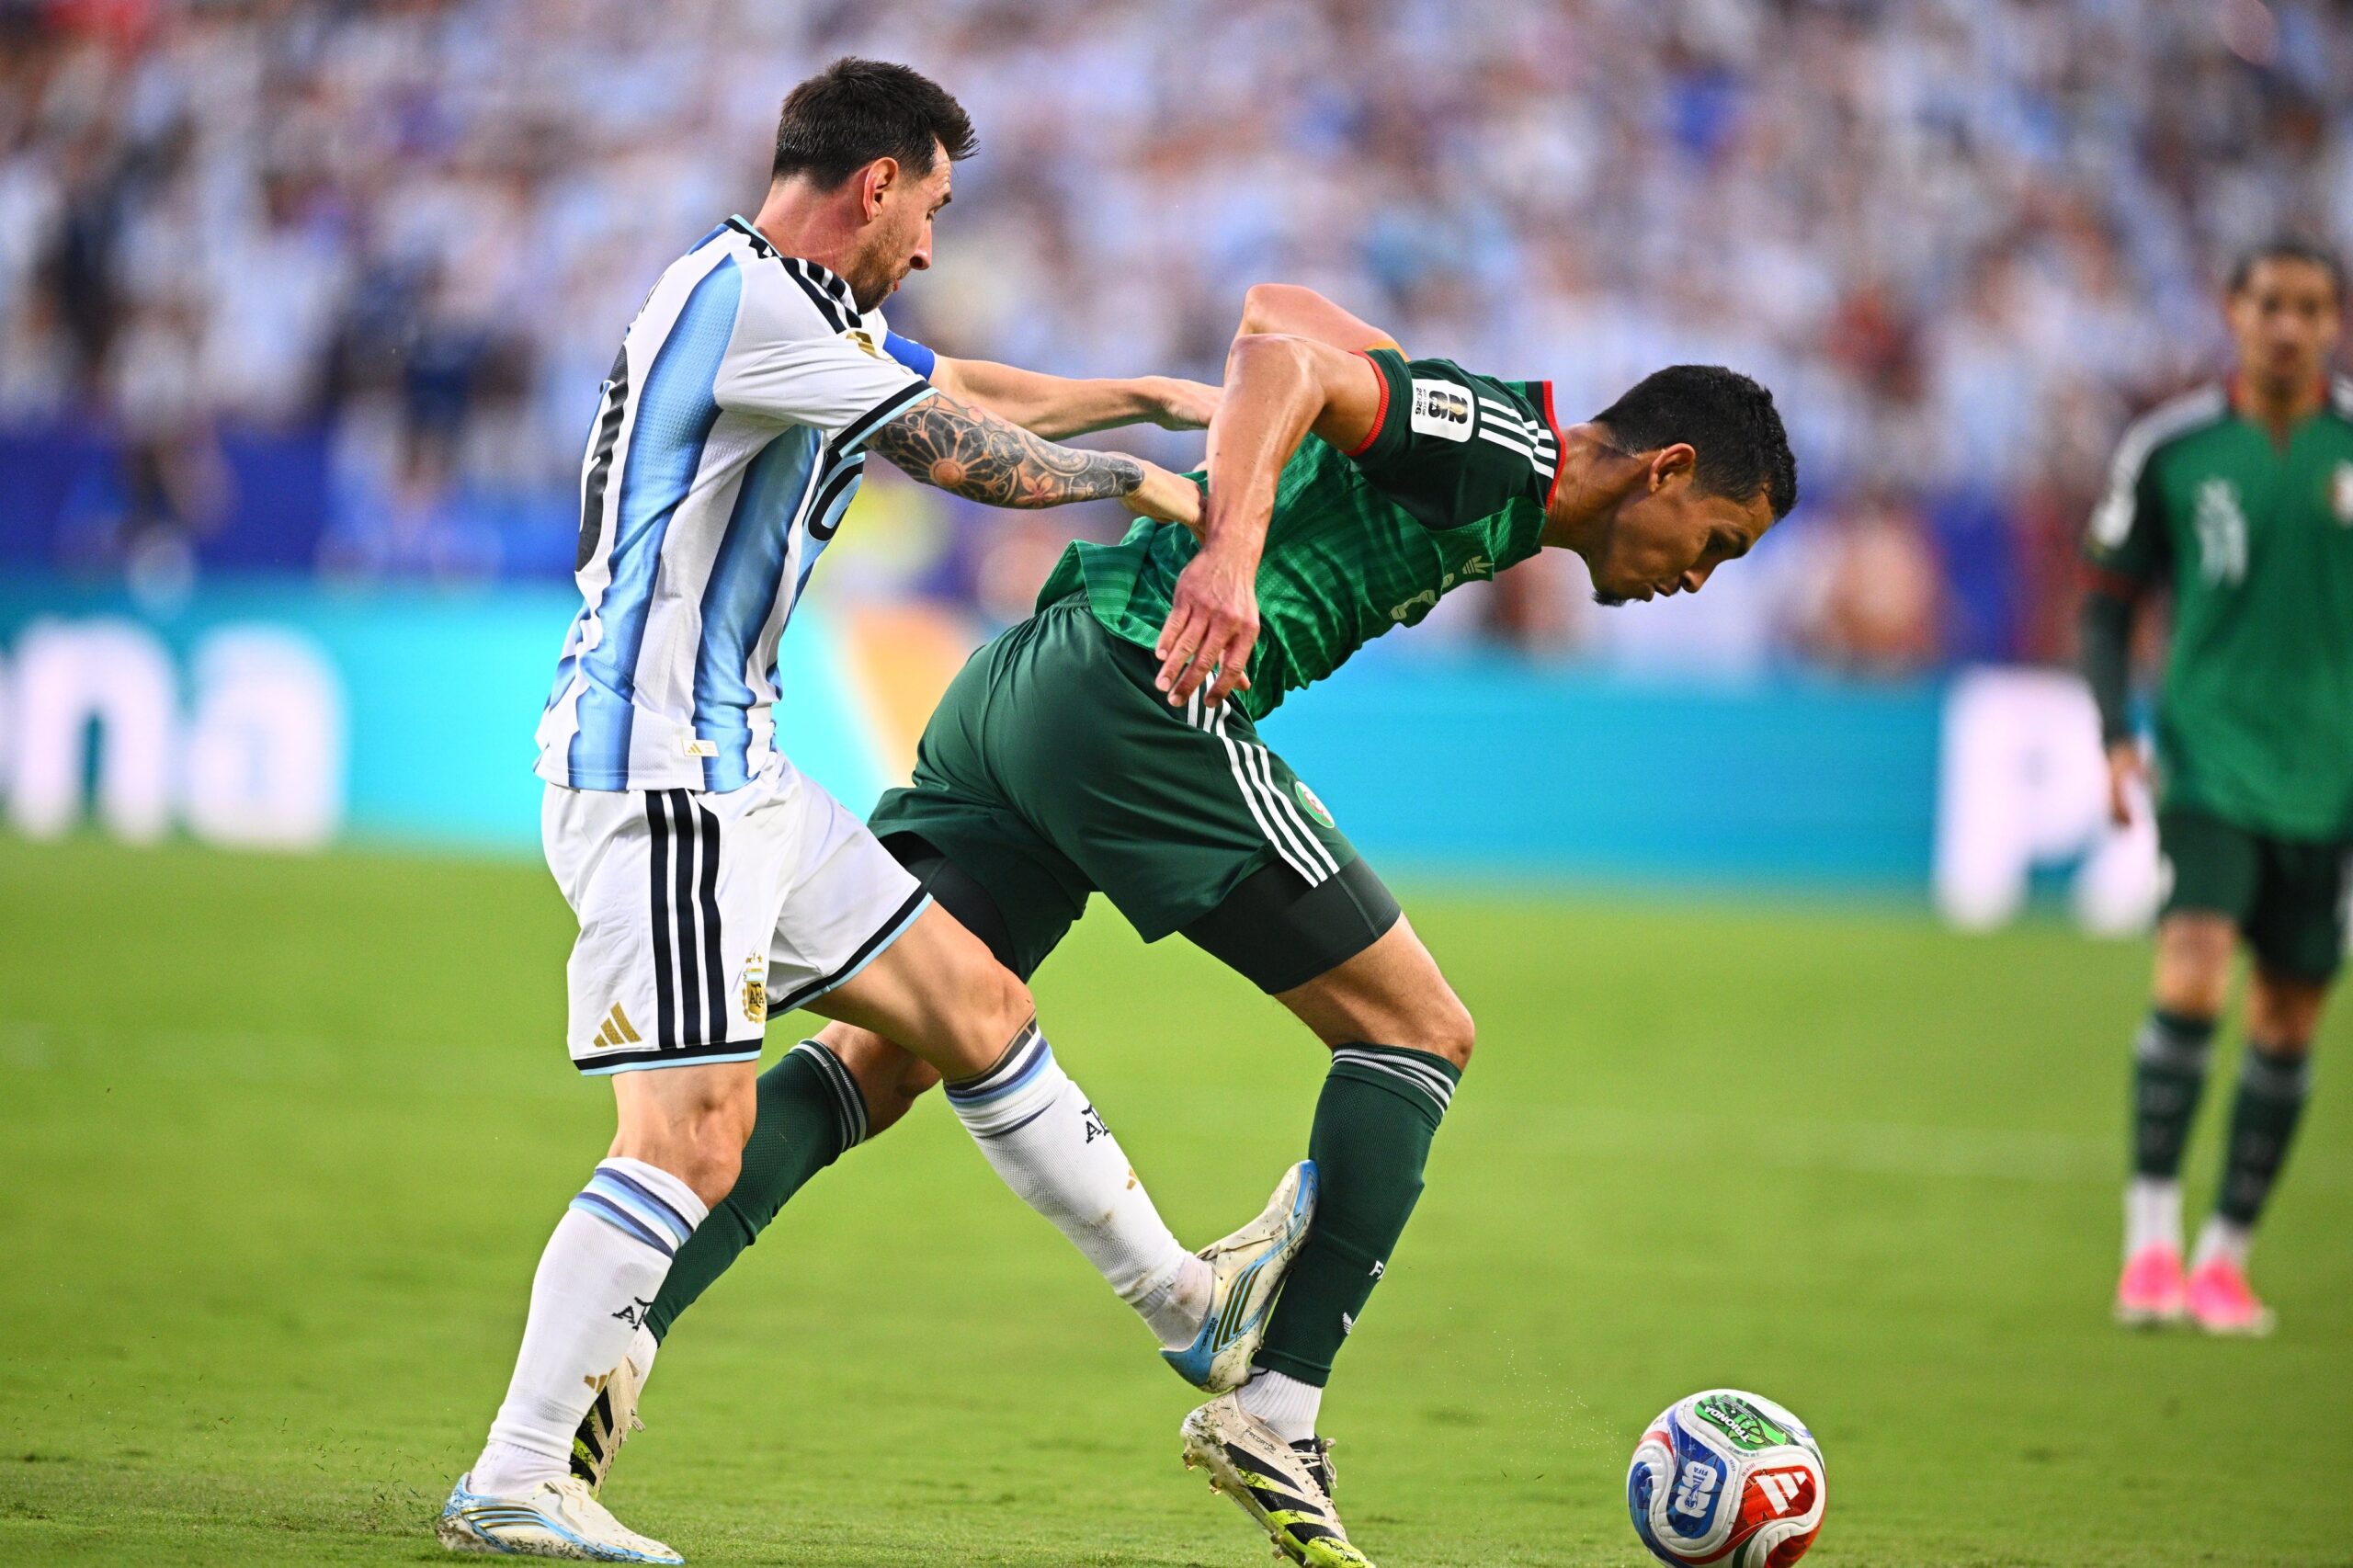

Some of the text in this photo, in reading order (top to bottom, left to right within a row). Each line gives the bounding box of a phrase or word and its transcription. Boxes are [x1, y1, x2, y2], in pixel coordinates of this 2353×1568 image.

[1704, 1404, 1751, 1443] TRIONDA
[1245, 1426, 1277, 1451] PREDATOR
[1693, 1466, 1709, 1476] FIFA
